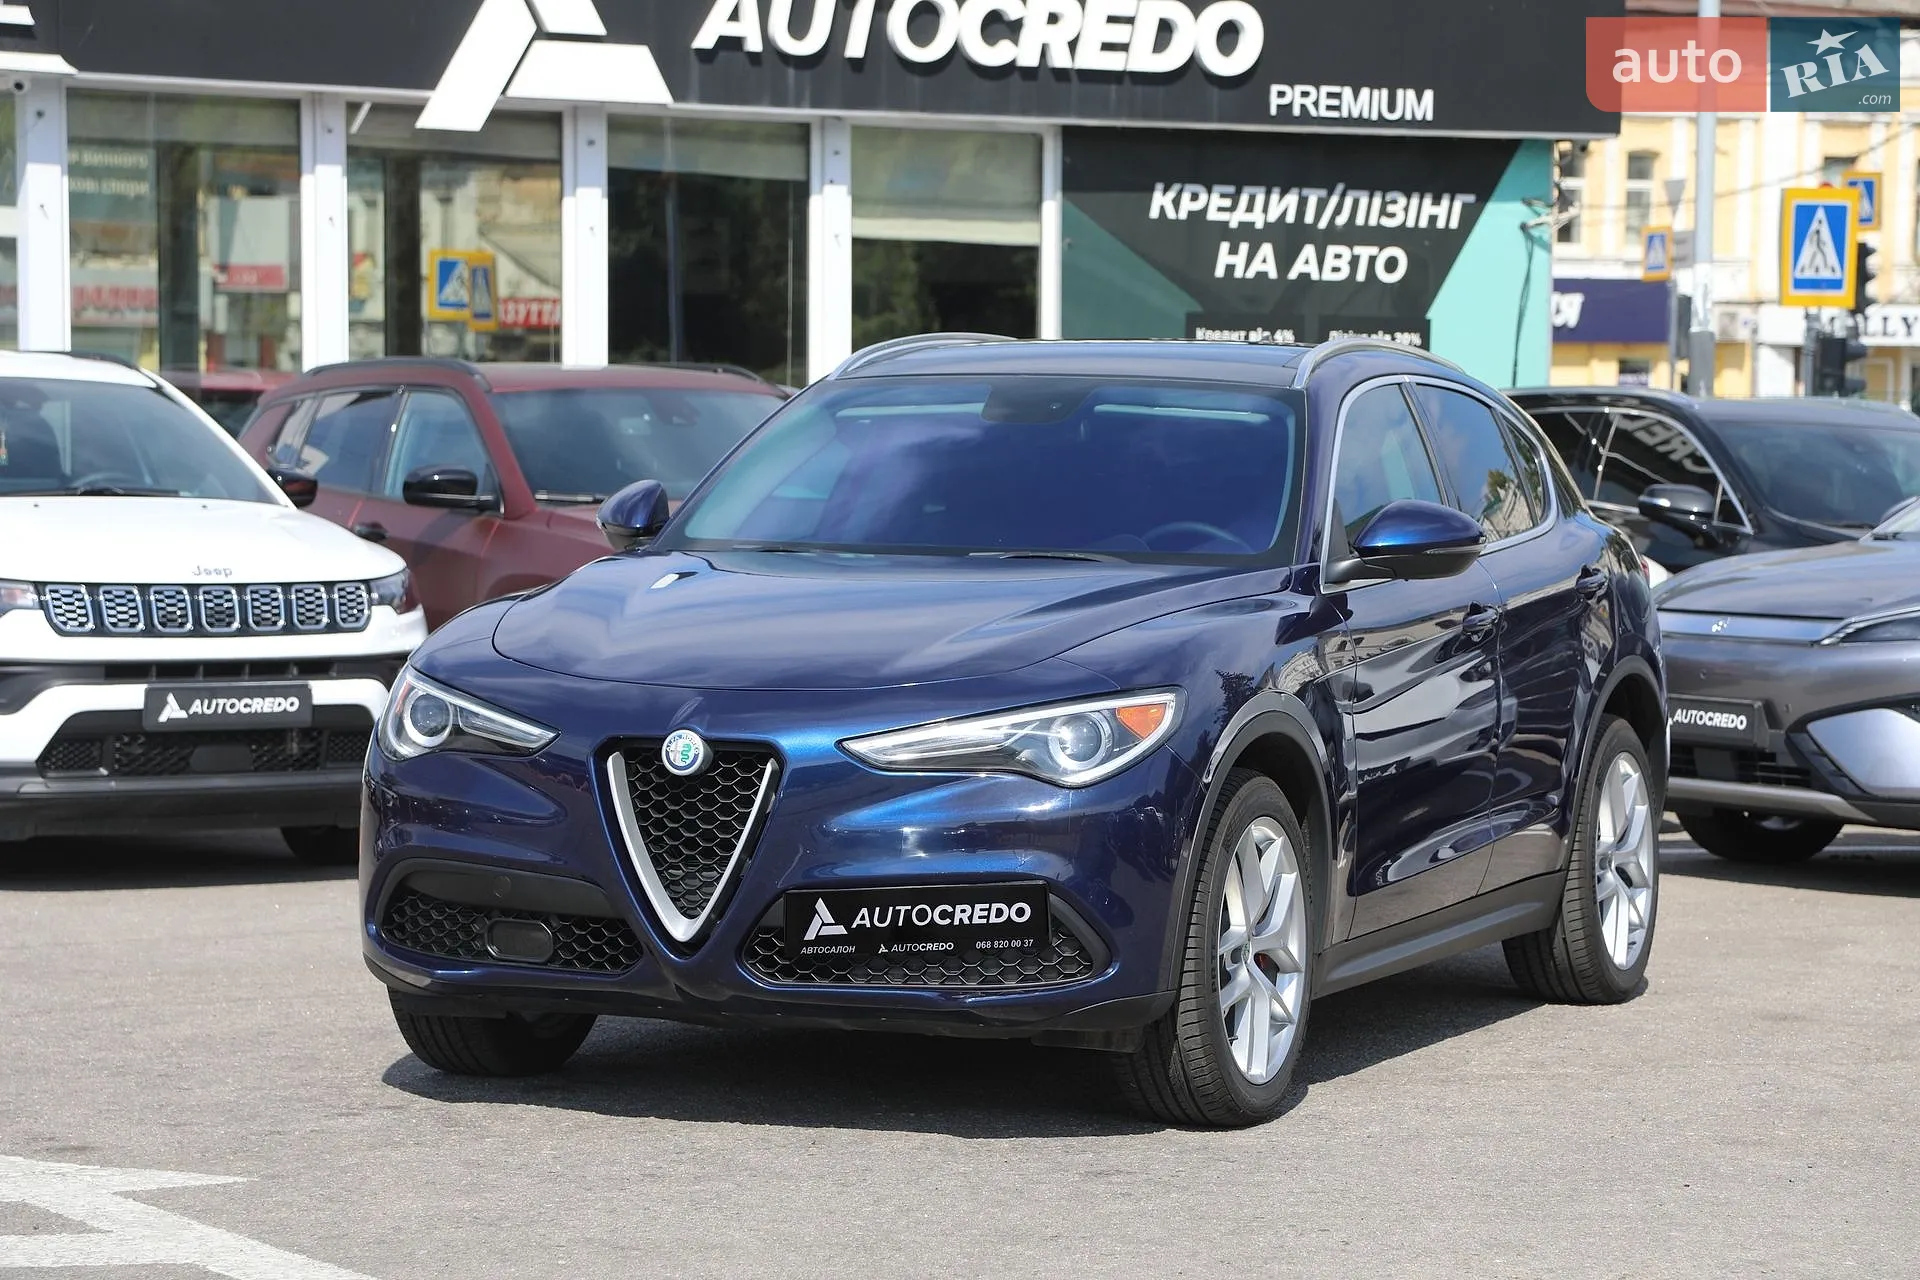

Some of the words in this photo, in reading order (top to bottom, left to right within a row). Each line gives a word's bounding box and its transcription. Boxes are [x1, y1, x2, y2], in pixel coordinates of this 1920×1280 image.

[690, 0, 1265, 77] AUTOCREDO
[1269, 83, 1435, 122] PREMIUM
[1148, 182, 1478, 230] КРЕДИТ/ЛІЗІНГ
[1213, 240, 1279, 280] НА
[1286, 243, 1409, 284] АВТО
[187, 696, 300, 715] AUTOCREDO
[1673, 708, 1748, 731] AUTOCREDO
[850, 902, 1032, 929] AUTOCREDO
[800, 945, 856, 954] АВТОСАЛОН
[890, 942, 955, 953] AUTOCREDO
[975, 940, 992, 950] 068
[993, 939, 1009, 949] 820
[1011, 939, 1022, 948] 00
[1023, 938, 1034, 948] 37
